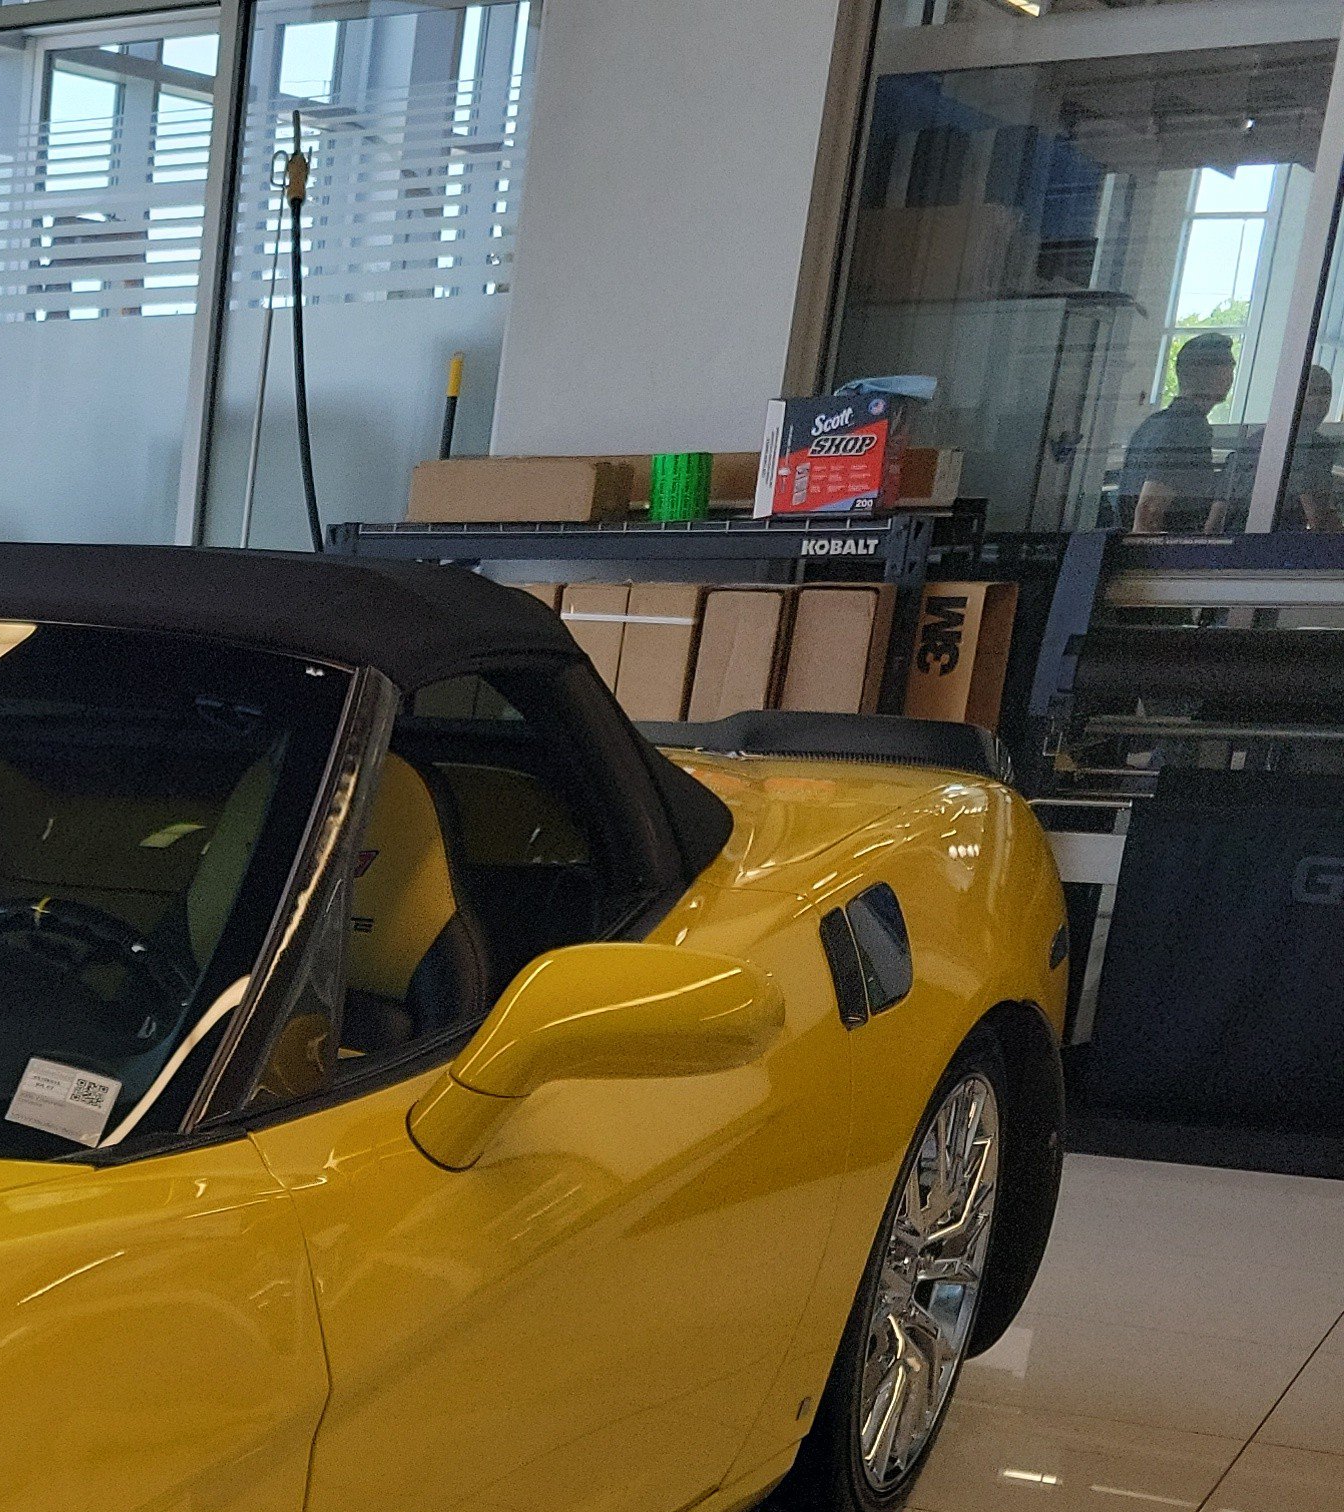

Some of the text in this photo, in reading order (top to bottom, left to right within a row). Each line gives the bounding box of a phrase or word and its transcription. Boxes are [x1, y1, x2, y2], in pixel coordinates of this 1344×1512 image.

[811, 407, 854, 436] Scott
[808, 435, 877, 456] SHOP
[855, 499, 874, 508] 200
[801, 539, 879, 556] KOBALT
[916, 596, 969, 677] 3M
